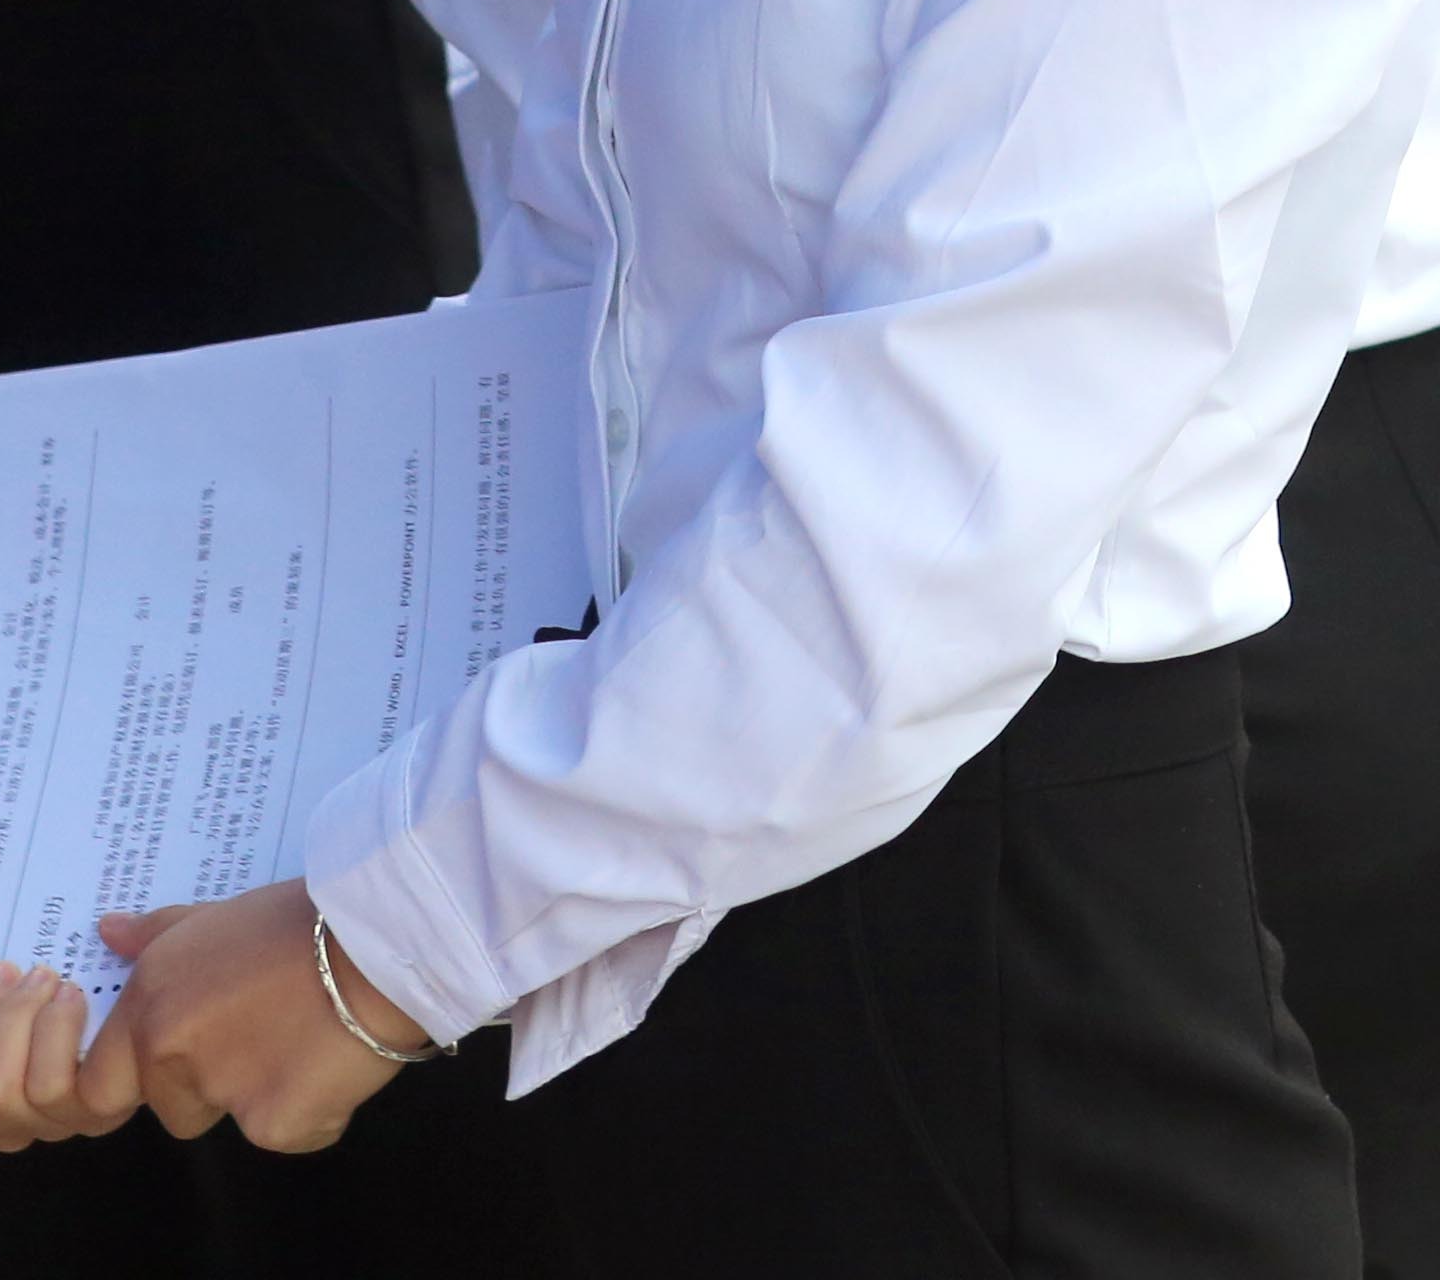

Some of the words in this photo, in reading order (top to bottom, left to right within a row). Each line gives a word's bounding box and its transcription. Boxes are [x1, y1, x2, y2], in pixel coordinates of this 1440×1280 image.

[399, 520, 415, 606] POWERPOINT
[0, 610, 18, 637] 会计
[133, 595, 151, 621] 会计
[201, 753, 218, 788] young
